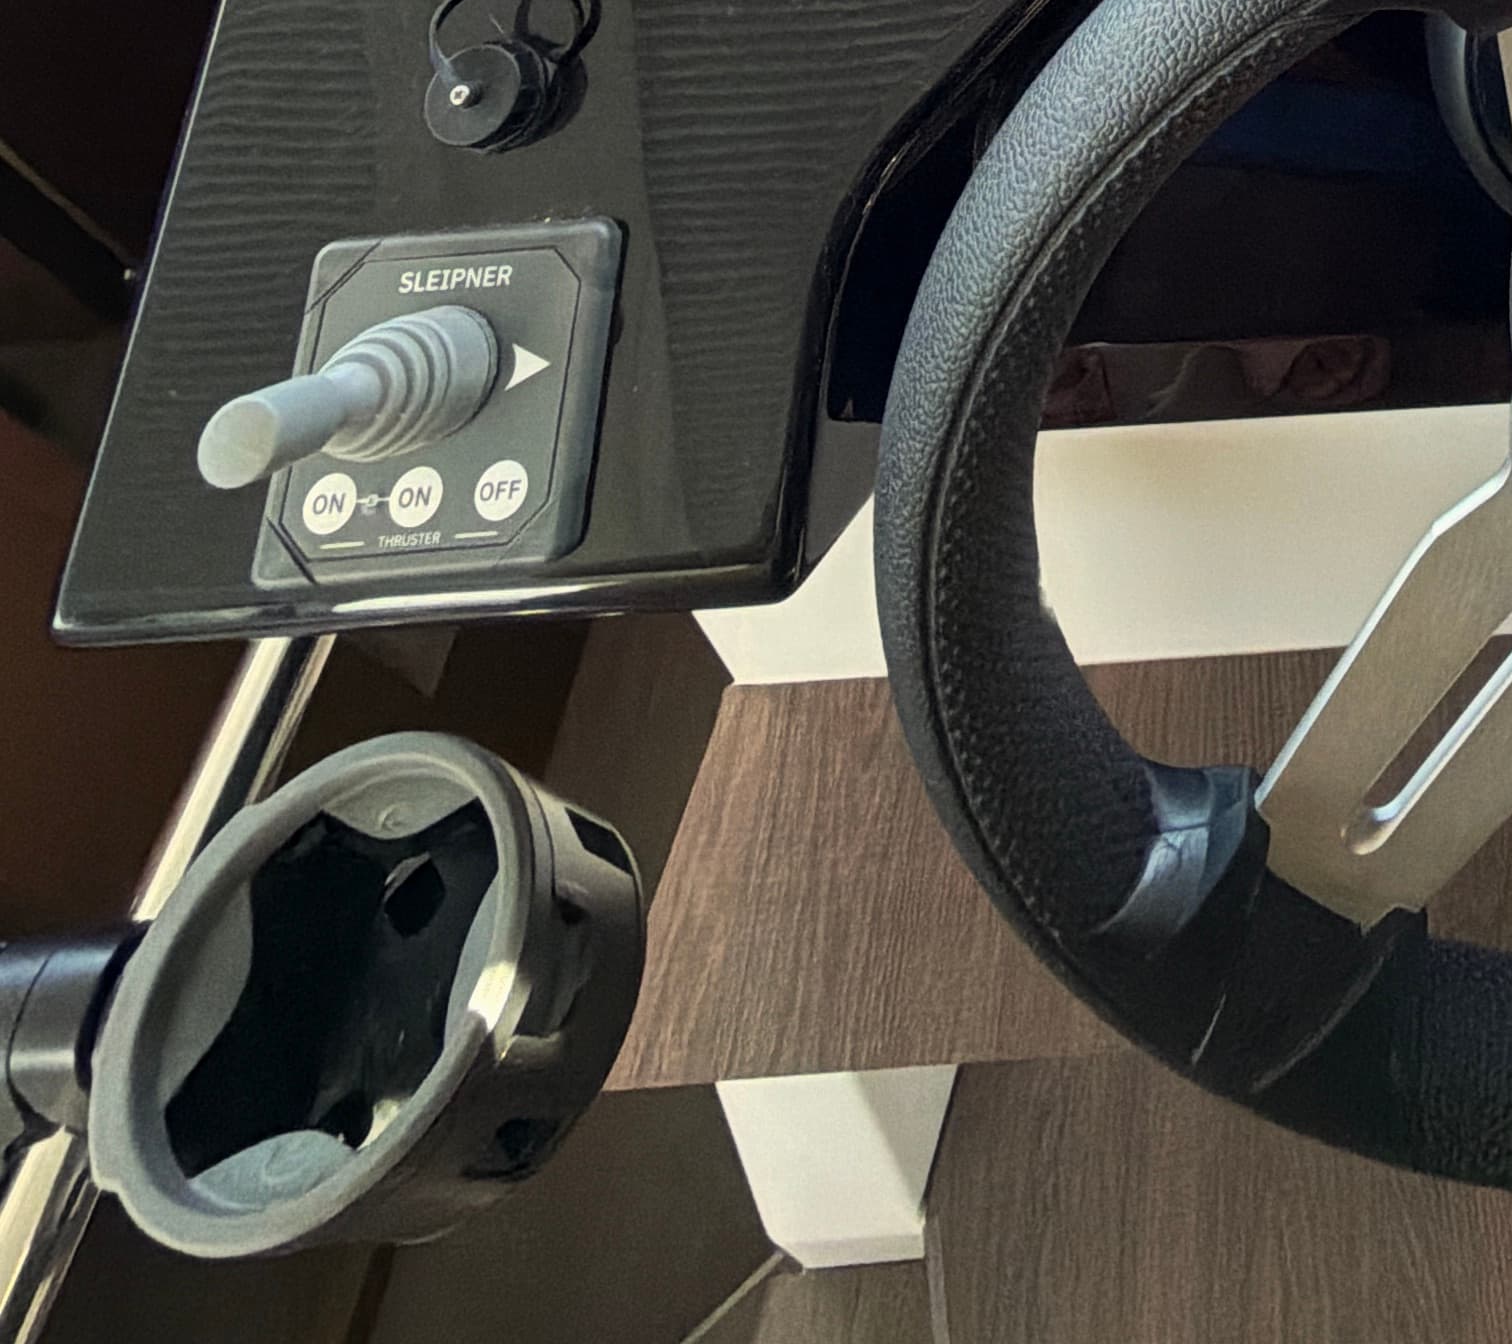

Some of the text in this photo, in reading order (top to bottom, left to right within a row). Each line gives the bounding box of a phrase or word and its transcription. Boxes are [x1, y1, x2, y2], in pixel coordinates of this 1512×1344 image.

[398, 264, 513, 294] SLEIPNER
[311, 479, 522, 515] ON ON OFF
[378, 531, 441, 549] THRUSTER
